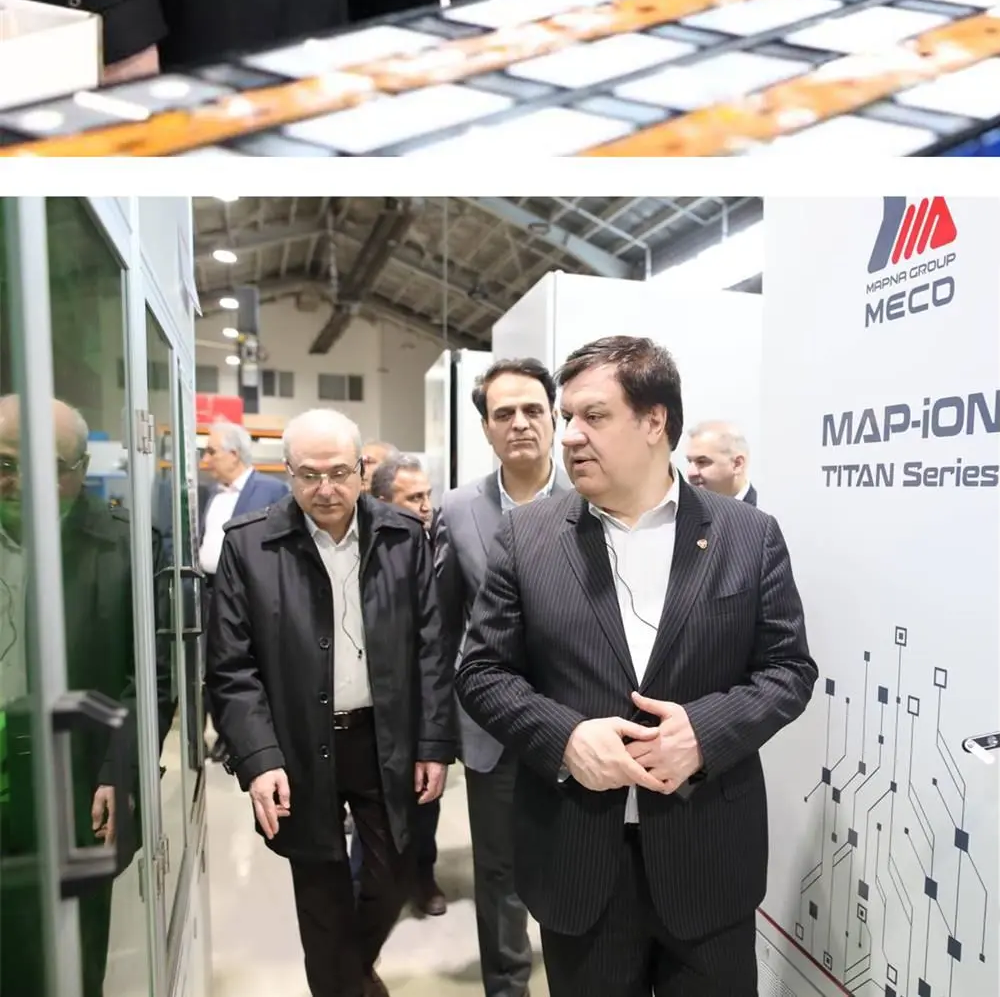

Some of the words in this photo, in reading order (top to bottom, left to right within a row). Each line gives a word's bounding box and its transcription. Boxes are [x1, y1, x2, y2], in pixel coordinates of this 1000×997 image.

[866, 271, 907, 294] MAPNA
[909, 252, 956, 279] GROUP
[865, 276, 955, 328] MECO
[822, 389, 1000, 446] MAP-iON
[822, 463, 894, 487] TITAN
[903, 458, 1000, 487] Series
